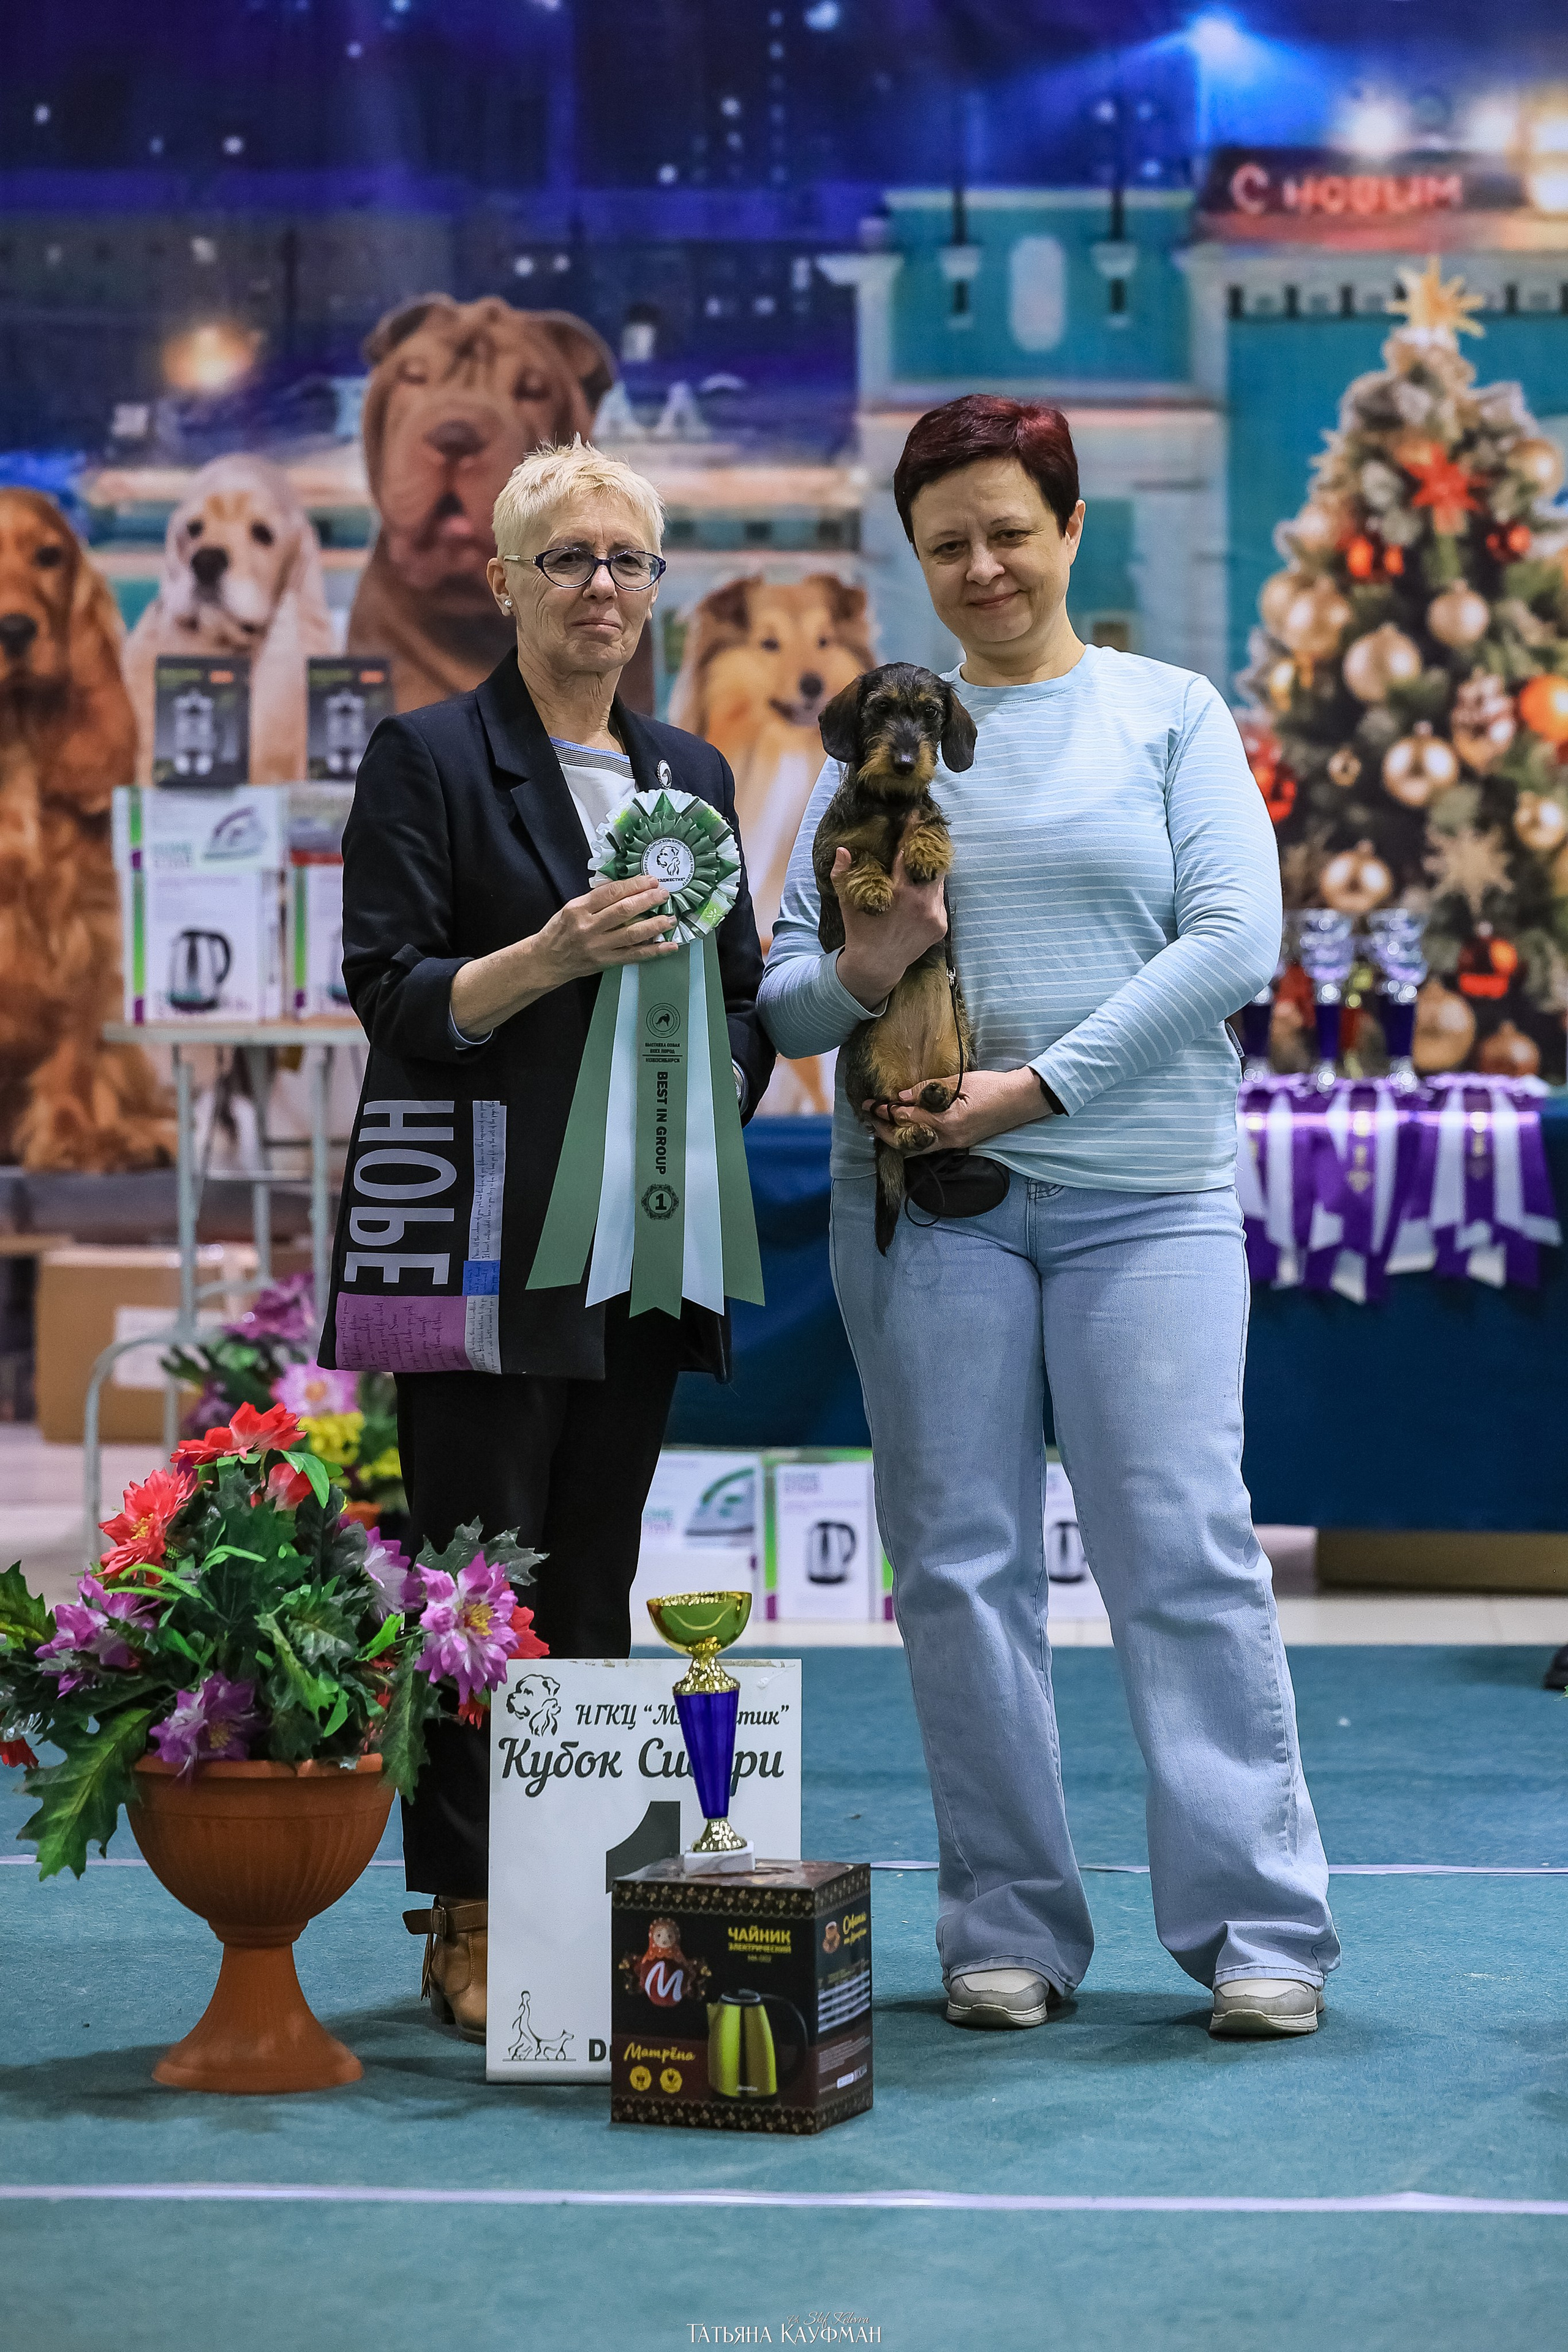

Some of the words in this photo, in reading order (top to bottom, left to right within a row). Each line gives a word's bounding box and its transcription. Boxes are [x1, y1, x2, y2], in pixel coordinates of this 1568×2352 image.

[656, 1071, 668, 1105] BEST
[655, 1107, 668, 1123] IN
[655, 1126, 667, 1175] GROUP
[655, 1193, 668, 1212] 1
[575, 1703, 637, 1730] НГКЦ
[498, 1737, 623, 1797] Кубок
[638, 1737, 785, 1797] Сири
[728, 1925, 791, 1944] ЧАЙНИК
